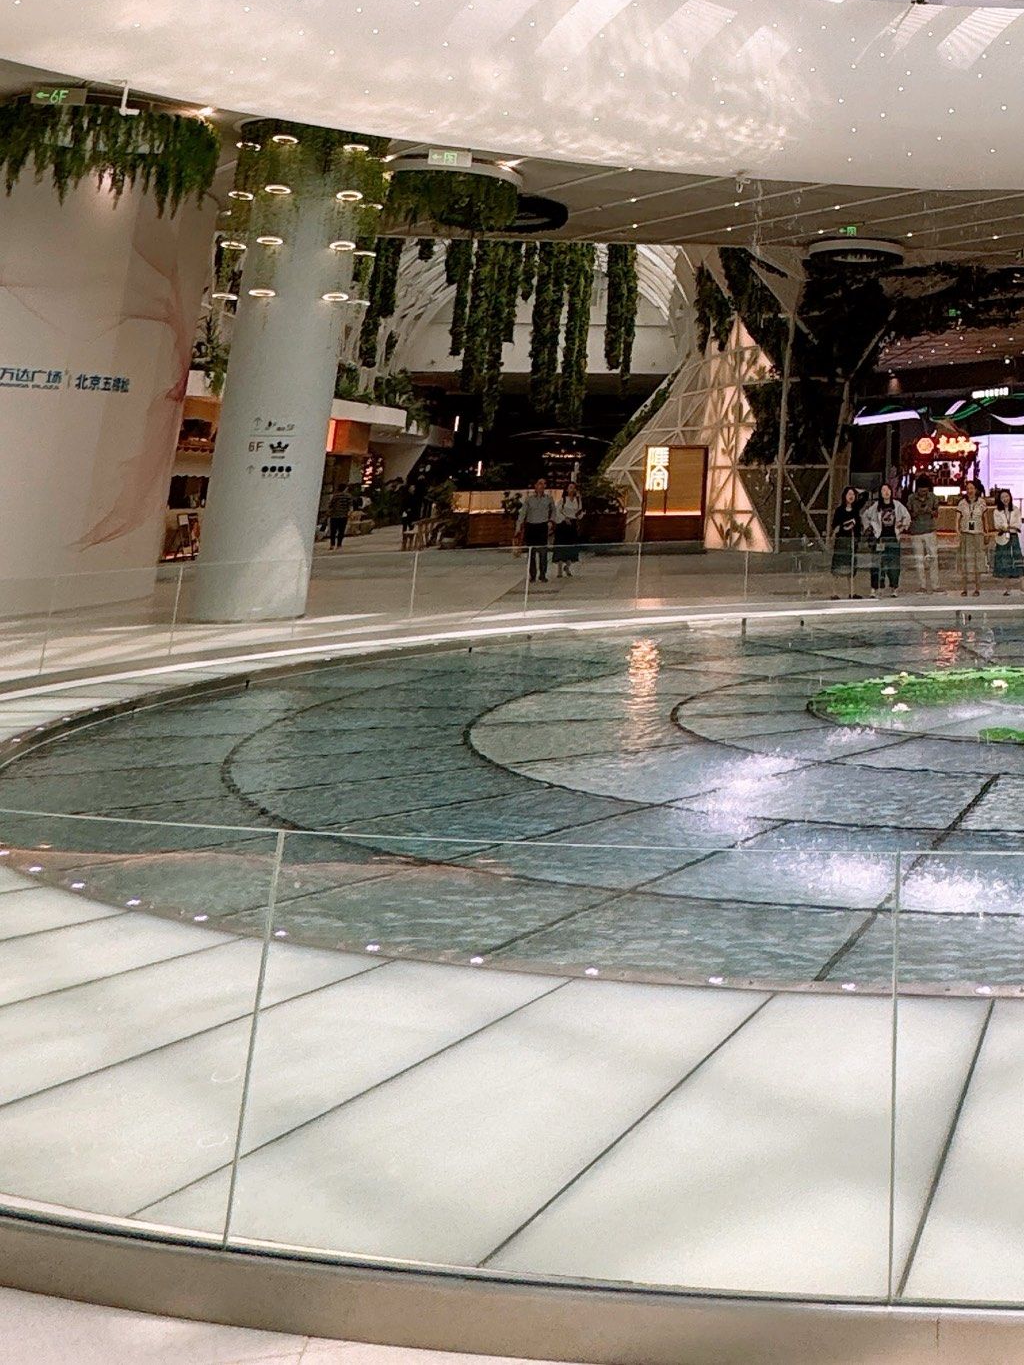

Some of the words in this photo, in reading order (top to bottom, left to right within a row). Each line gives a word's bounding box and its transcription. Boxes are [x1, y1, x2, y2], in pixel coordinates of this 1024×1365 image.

[50, 89, 69, 104] 6F
[0, 367, 62, 384] 万达广场
[248, 441, 264, 452] 6F
